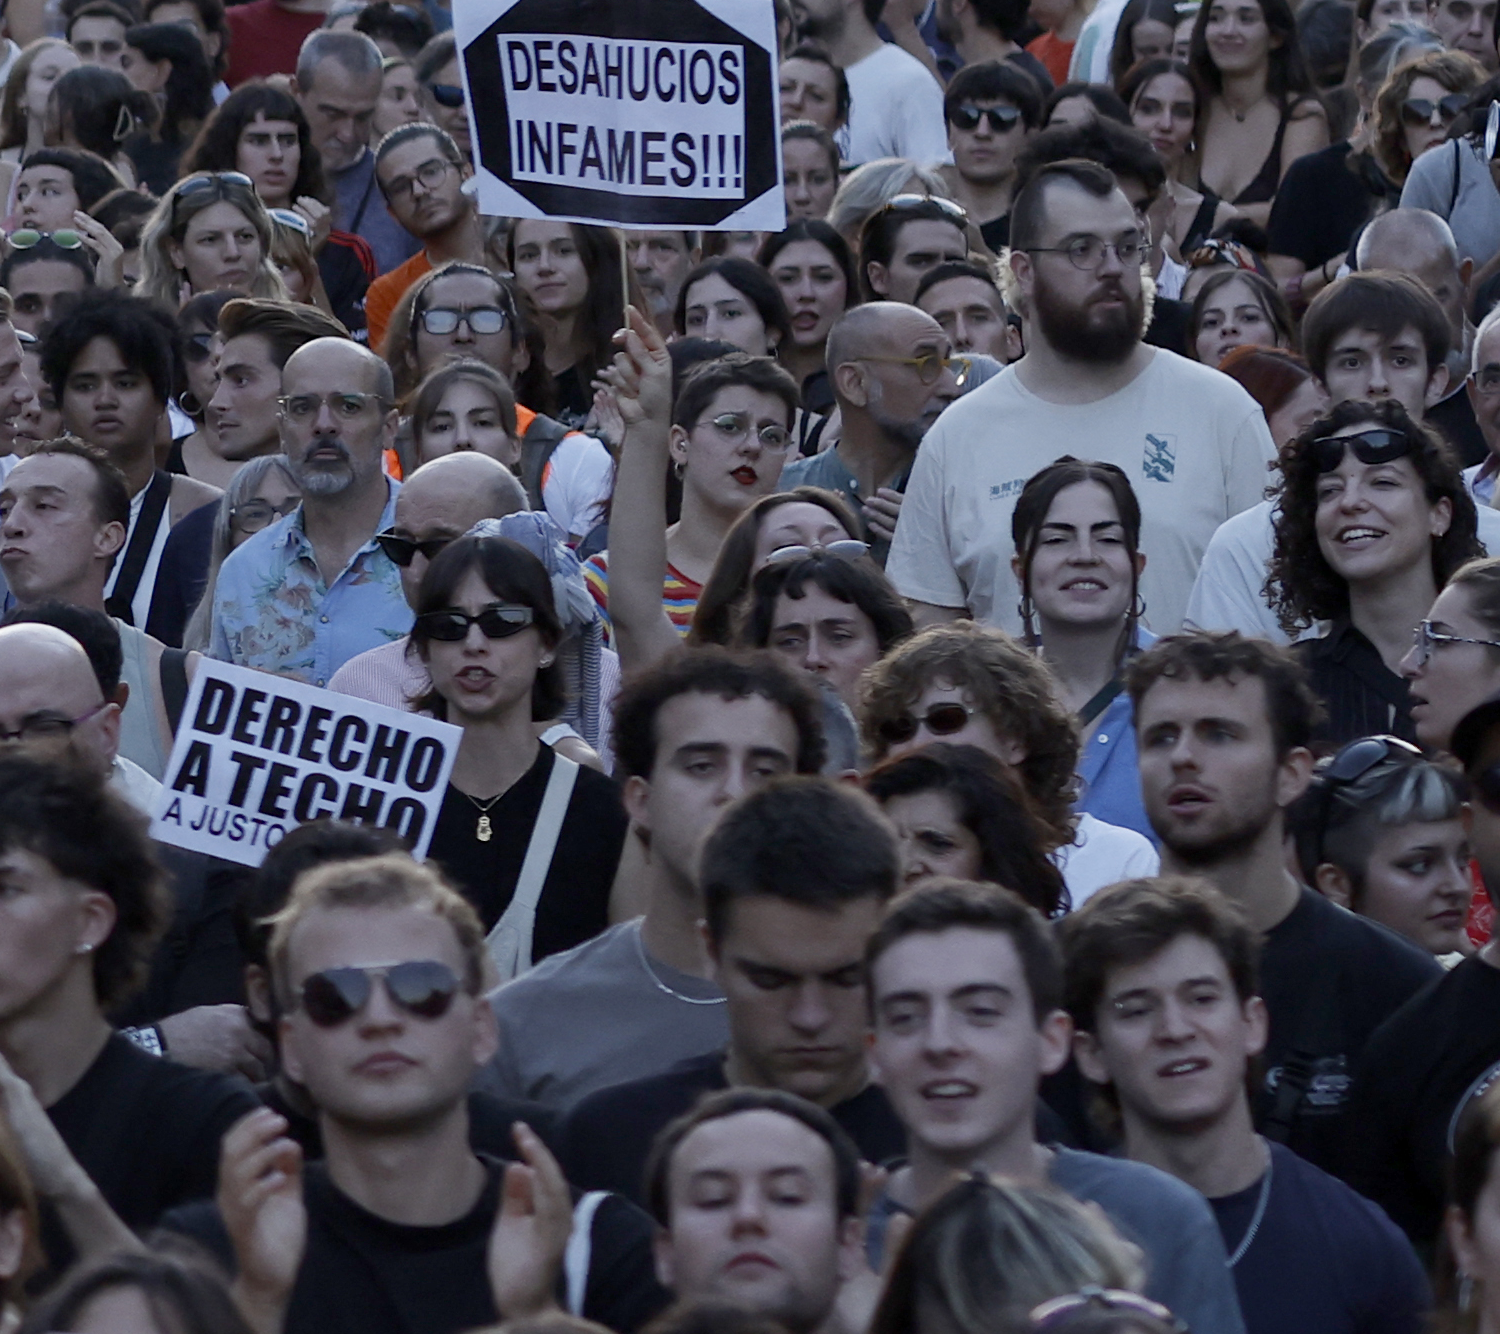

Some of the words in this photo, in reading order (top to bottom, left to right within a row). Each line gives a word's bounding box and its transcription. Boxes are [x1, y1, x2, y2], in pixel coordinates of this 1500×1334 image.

[504, 38, 741, 107] DESAHUCIOS
[513, 120, 742, 191] INFAMES!!!
[168, 740, 214, 798] A
[191, 677, 445, 794] DERECHO
[161, 798, 183, 823] A
